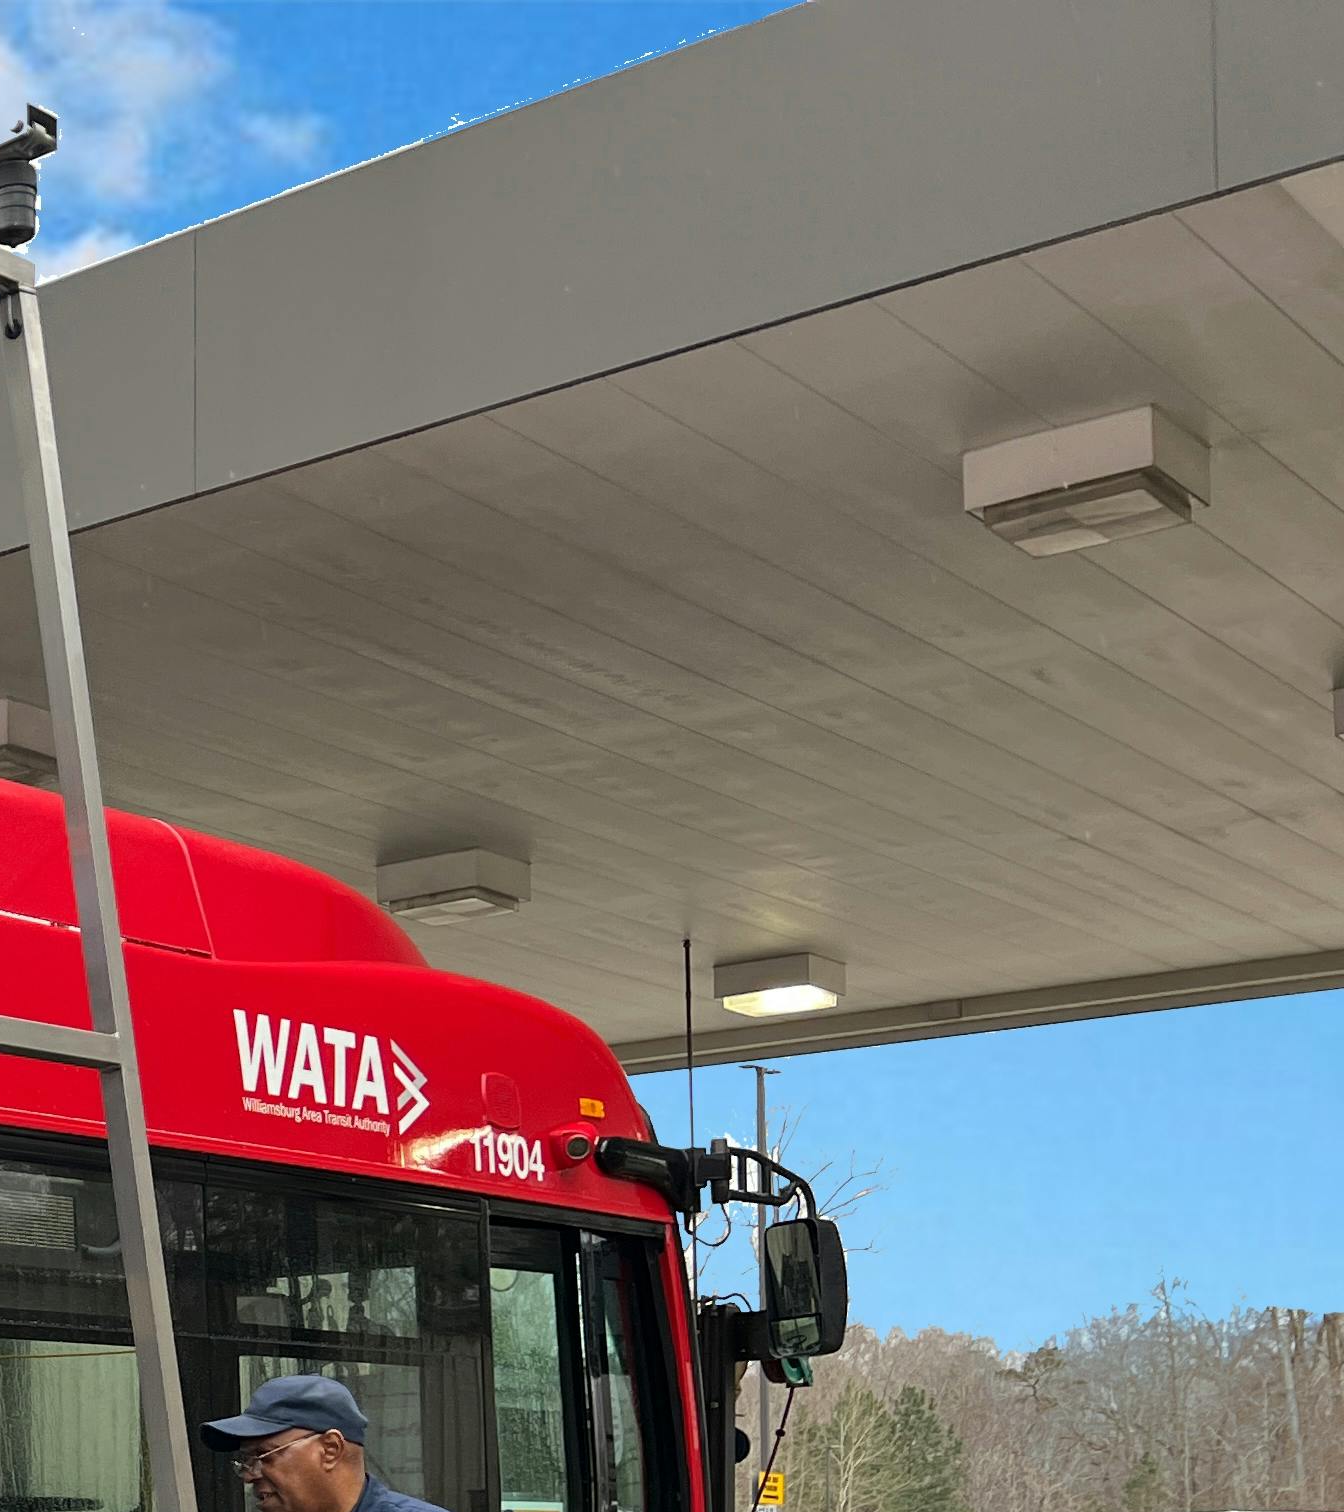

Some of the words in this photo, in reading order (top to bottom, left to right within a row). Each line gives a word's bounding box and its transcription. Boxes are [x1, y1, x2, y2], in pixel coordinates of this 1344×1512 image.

[233, 1009, 390, 1115] WATA
[242, 1097, 303, 1123] Williamsburg
[302, 1106, 323, 1123] Area
[323, 1110, 352, 1128] Transit
[353, 1116, 391, 1137] Authority
